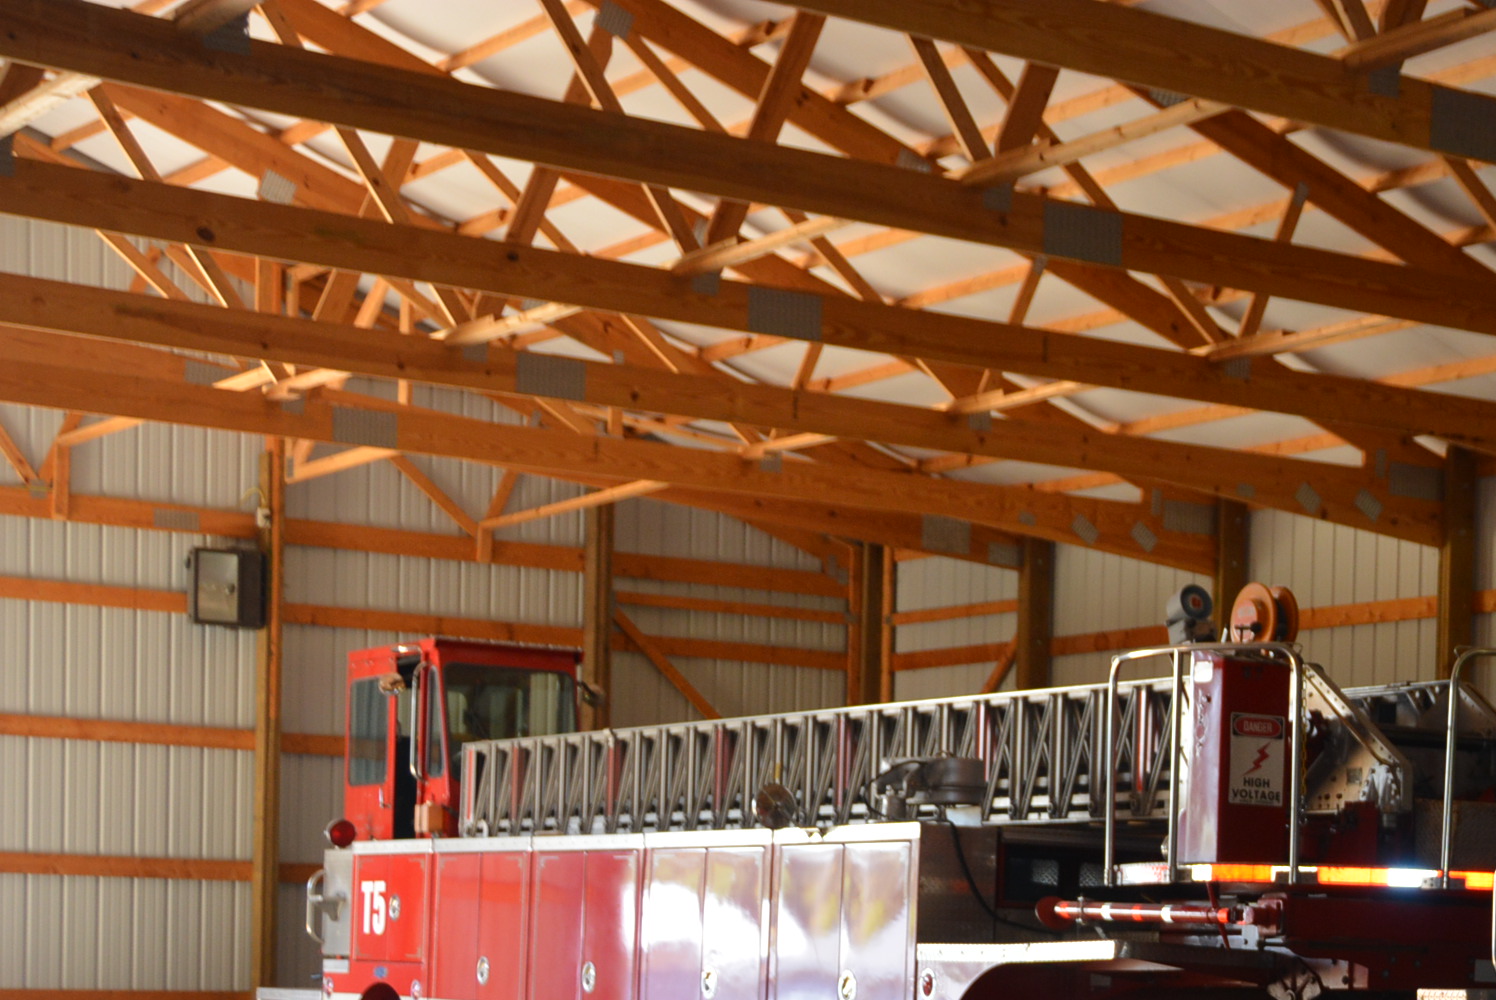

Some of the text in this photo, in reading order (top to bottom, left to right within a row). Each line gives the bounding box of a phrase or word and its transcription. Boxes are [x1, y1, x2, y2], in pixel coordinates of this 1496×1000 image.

[1243, 720, 1273, 732] DANGER
[1243, 777, 1270, 788] HIGH
[1232, 789, 1280, 803] VOLTAGE
[361, 880, 386, 935] T5
